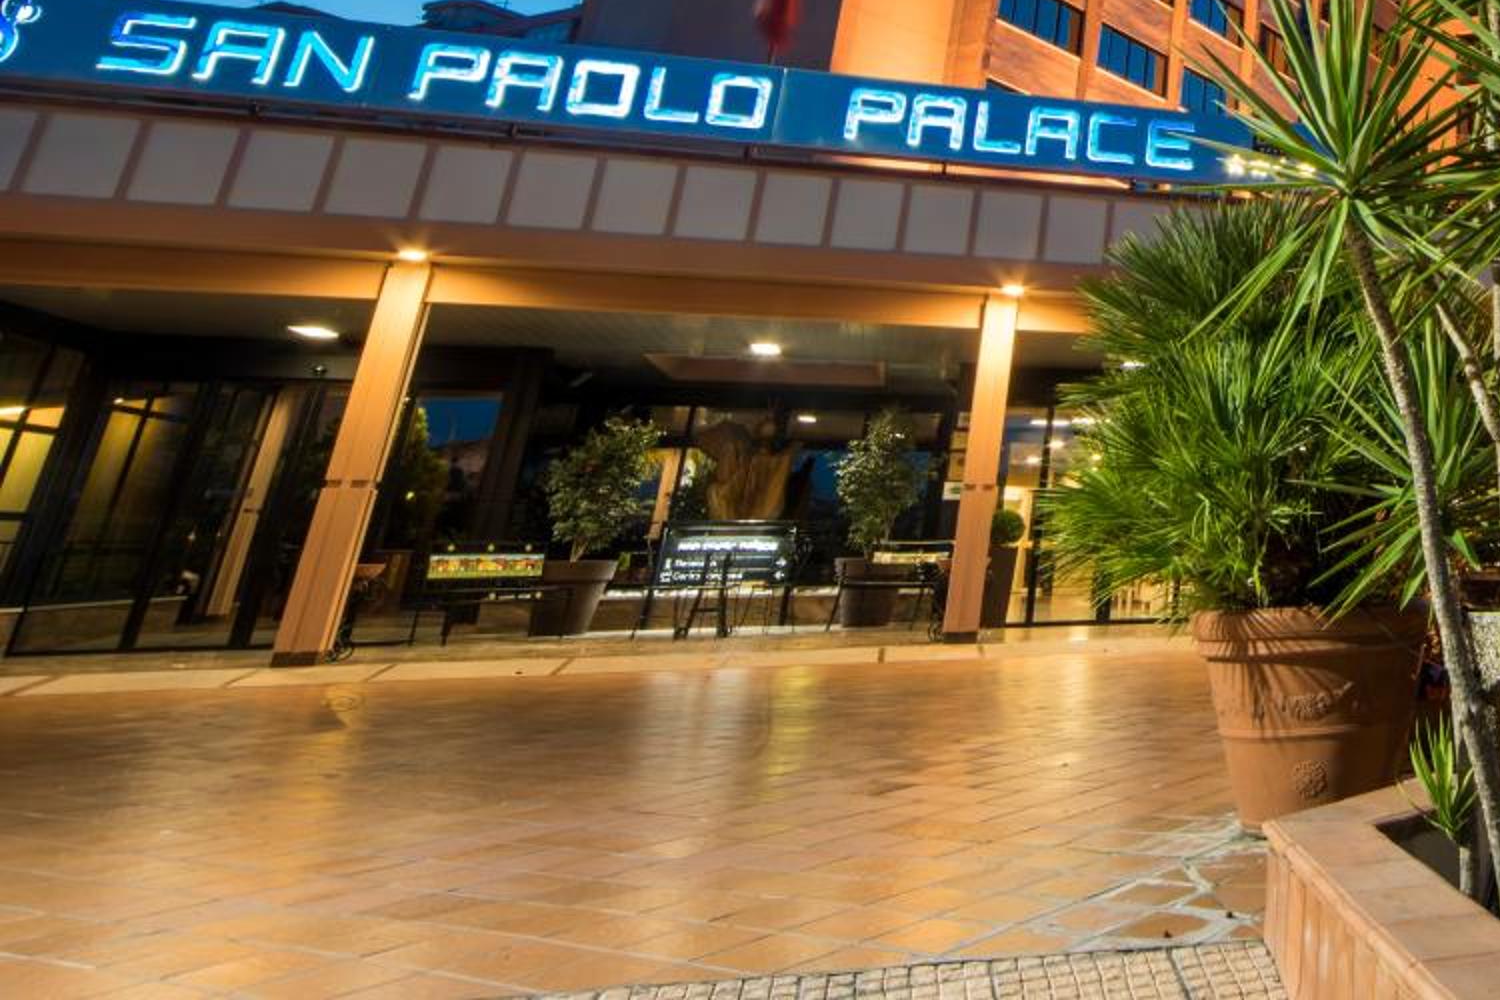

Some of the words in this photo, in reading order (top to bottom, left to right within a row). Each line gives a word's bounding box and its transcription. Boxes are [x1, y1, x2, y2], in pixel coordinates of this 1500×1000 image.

[95, 12, 375, 93] SAN
[408, 42, 774, 129] PAOLO
[842, 85, 1198, 171] PALACE
